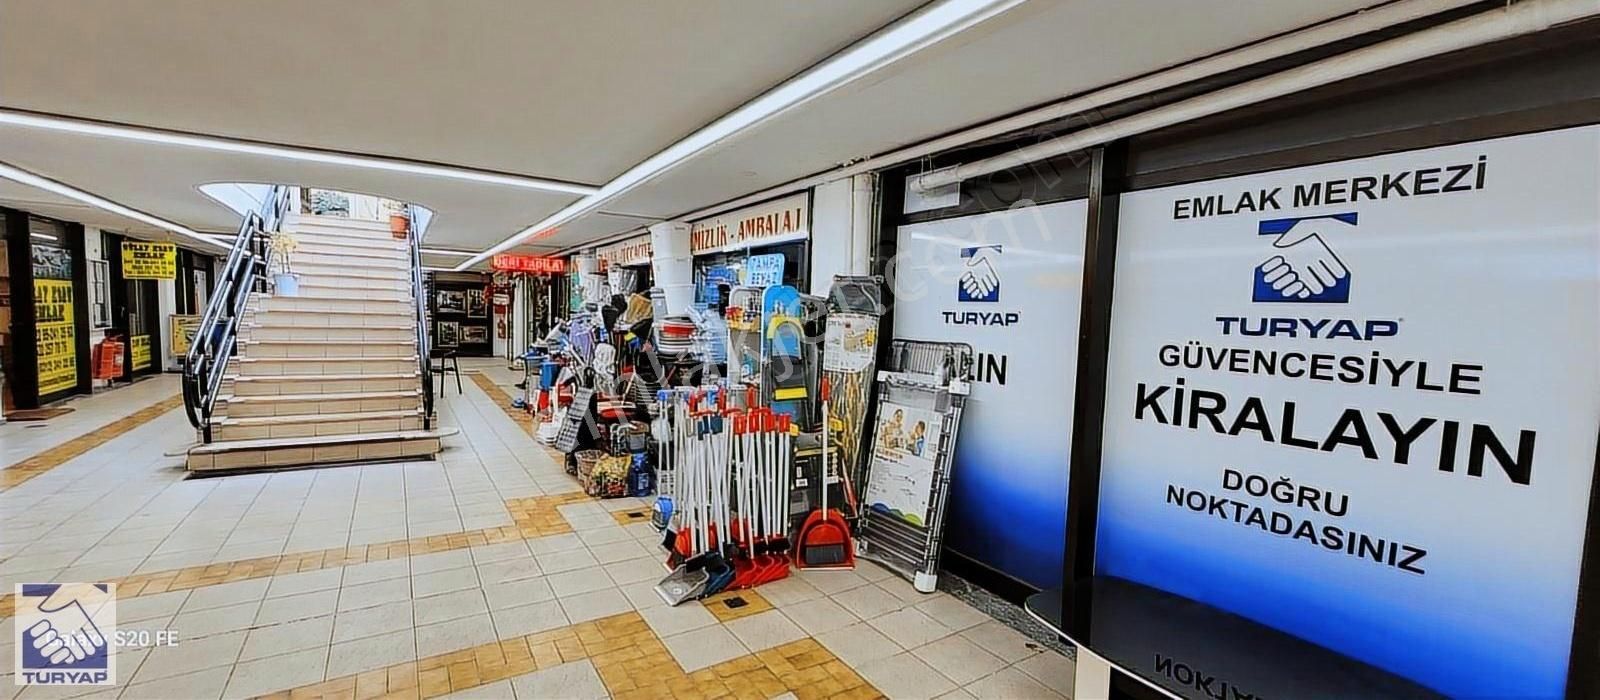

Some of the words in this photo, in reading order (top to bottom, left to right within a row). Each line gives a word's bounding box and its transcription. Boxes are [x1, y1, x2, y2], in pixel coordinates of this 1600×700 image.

[1173, 187, 1281, 220] EMLAK
[1293, 155, 1487, 208] MERKEZİ
[738, 208, 802, 241] AMBALAJ
[942, 312, 1019, 327] TURYAP
[1216, 316, 1399, 341] TURYAP
[1158, 342, 1484, 395] GÜVENCESİYLE
[1134, 378, 1537, 486] KİRALAYIN
[1222, 468, 1349, 517] DOĞRU
[1166, 484, 1427, 575] NOKTADASINIZ
